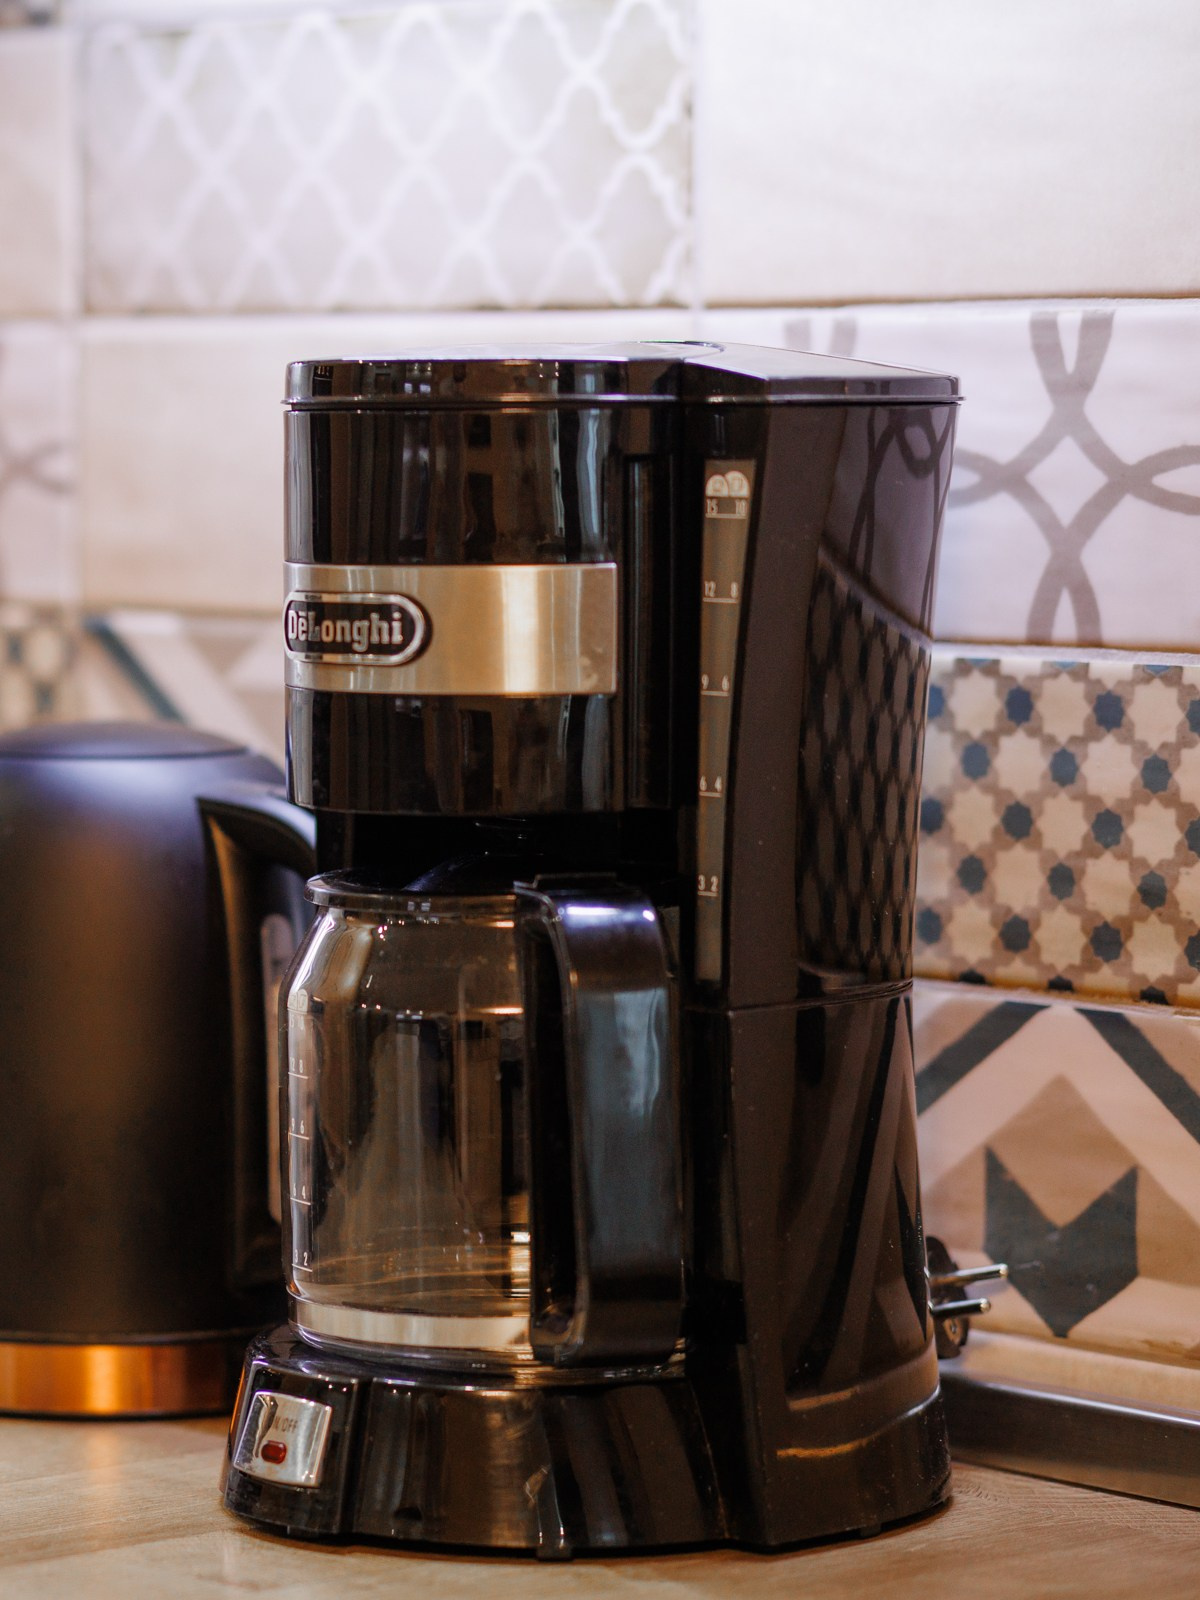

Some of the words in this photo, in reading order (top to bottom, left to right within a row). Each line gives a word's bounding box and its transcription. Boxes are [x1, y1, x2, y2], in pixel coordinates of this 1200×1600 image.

[707, 498, 718, 515] 15
[735, 499, 748, 517] 10
[704, 580, 716, 597] 12
[730, 581, 739, 599] 8
[701, 674, 709, 690] 9
[721, 674, 730, 691] 6
[699, 775, 707, 791] 6
[714, 775, 722, 792] 4
[698, 874, 706, 891] 3
[710, 875, 719, 892] 2
[300, 1119, 305, 1135] 6
[303, 1251, 308, 1266] 2
